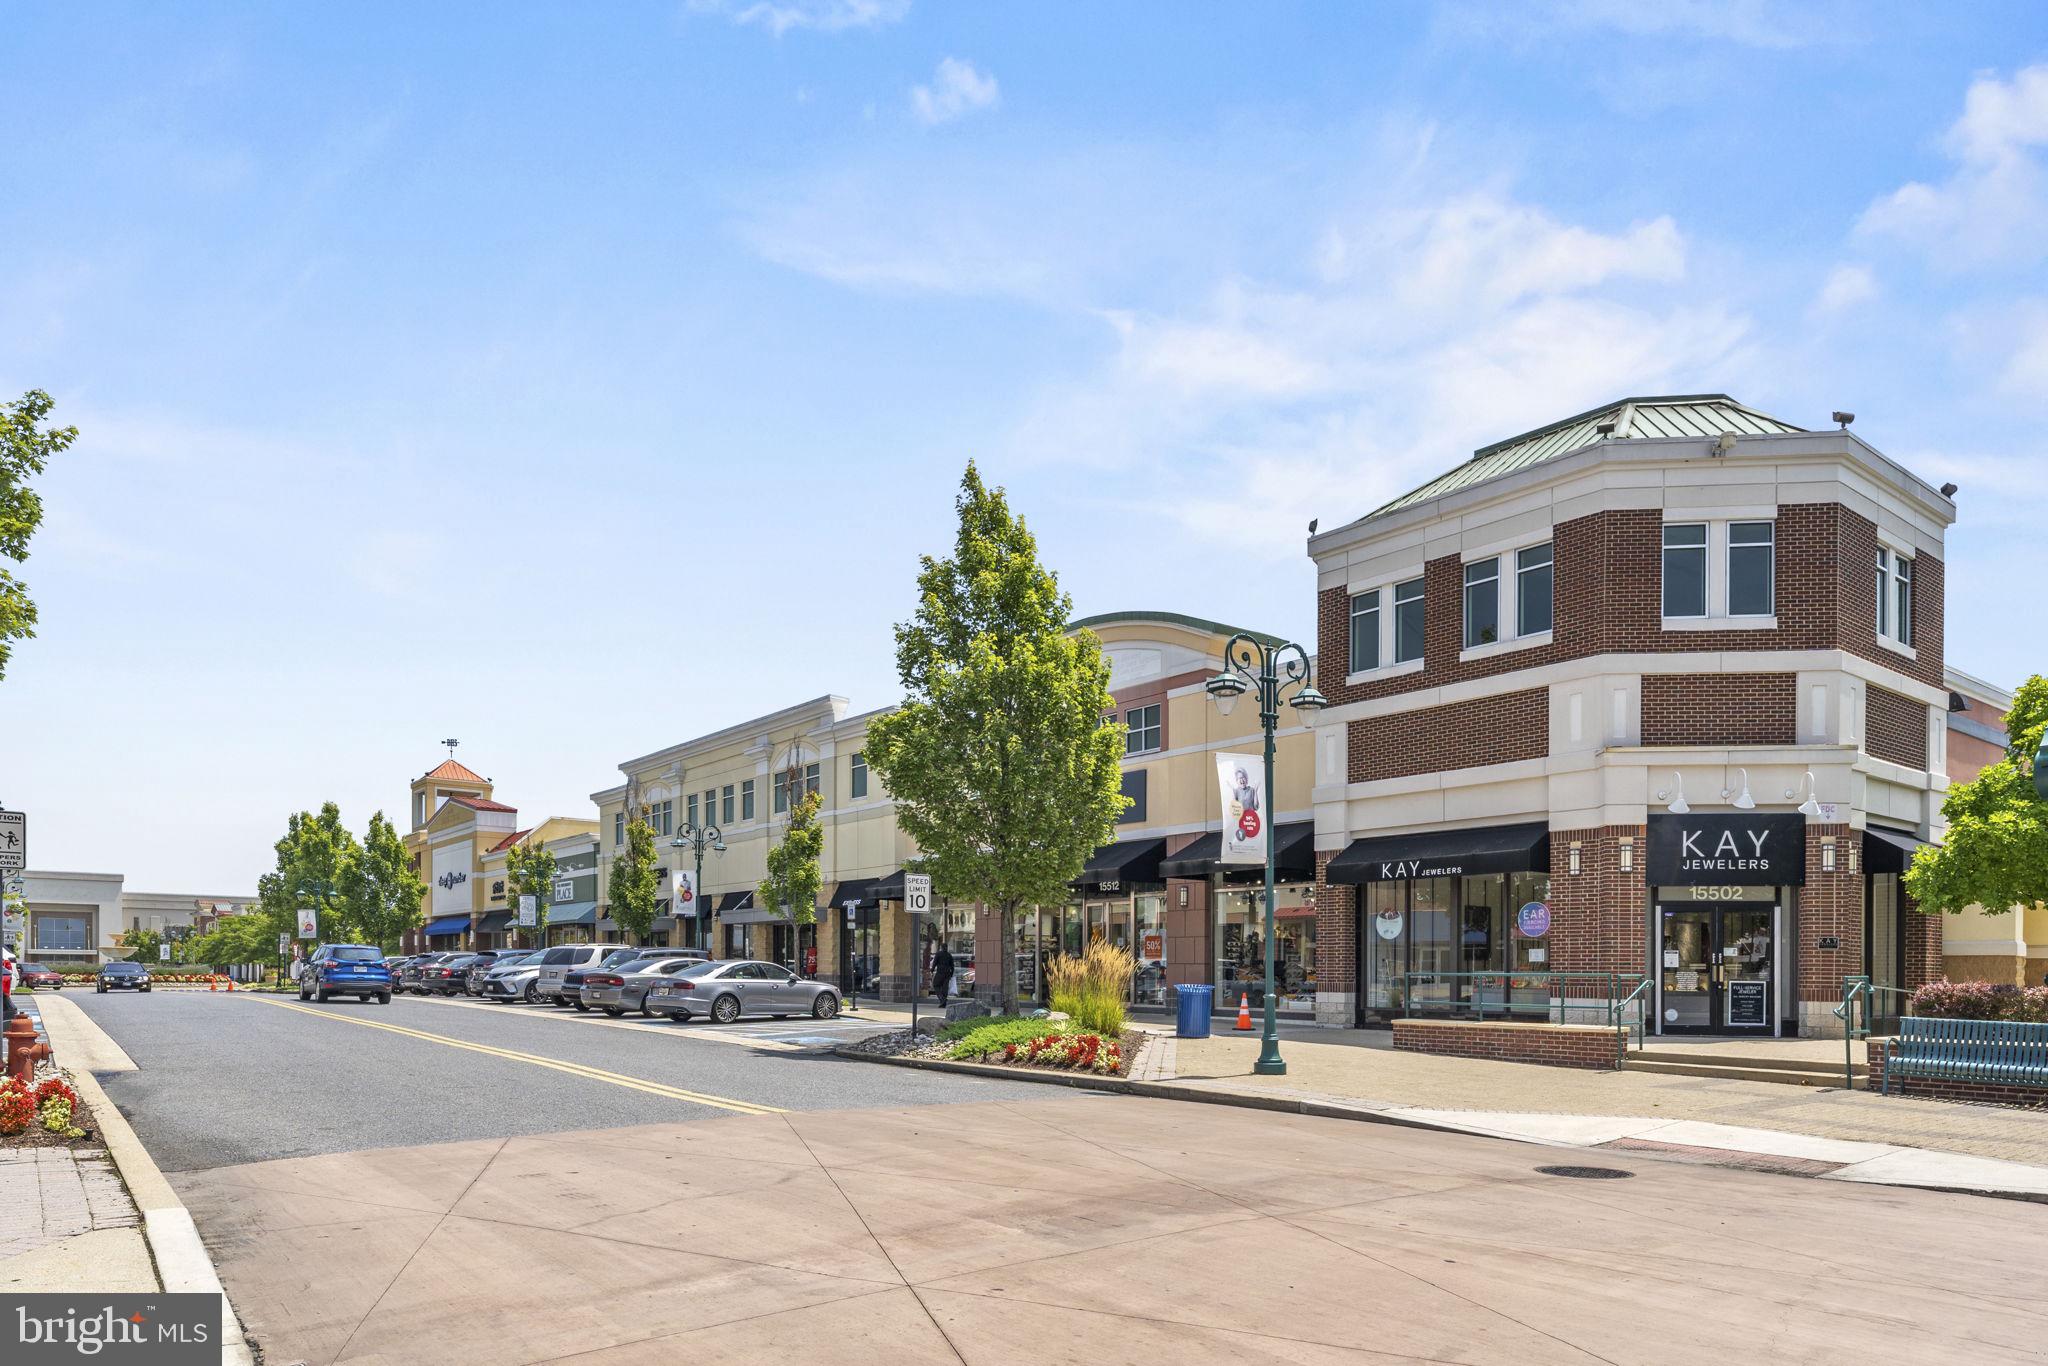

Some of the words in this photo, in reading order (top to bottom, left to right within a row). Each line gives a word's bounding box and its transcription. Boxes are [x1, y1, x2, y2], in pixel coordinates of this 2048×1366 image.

[1682, 829, 1770, 858] KAY
[1382, 860, 1421, 879] KAY
[1421, 866, 1463, 877] JEWELERS
[1682, 859, 1769, 870] JEWELERS
[907, 877, 929, 885] SPEED
[1099, 881, 1120, 891] 15512
[1689, 885, 1743, 900] 15502
[909, 894, 926, 909] 10
[1523, 909, 1545, 920] EAR
